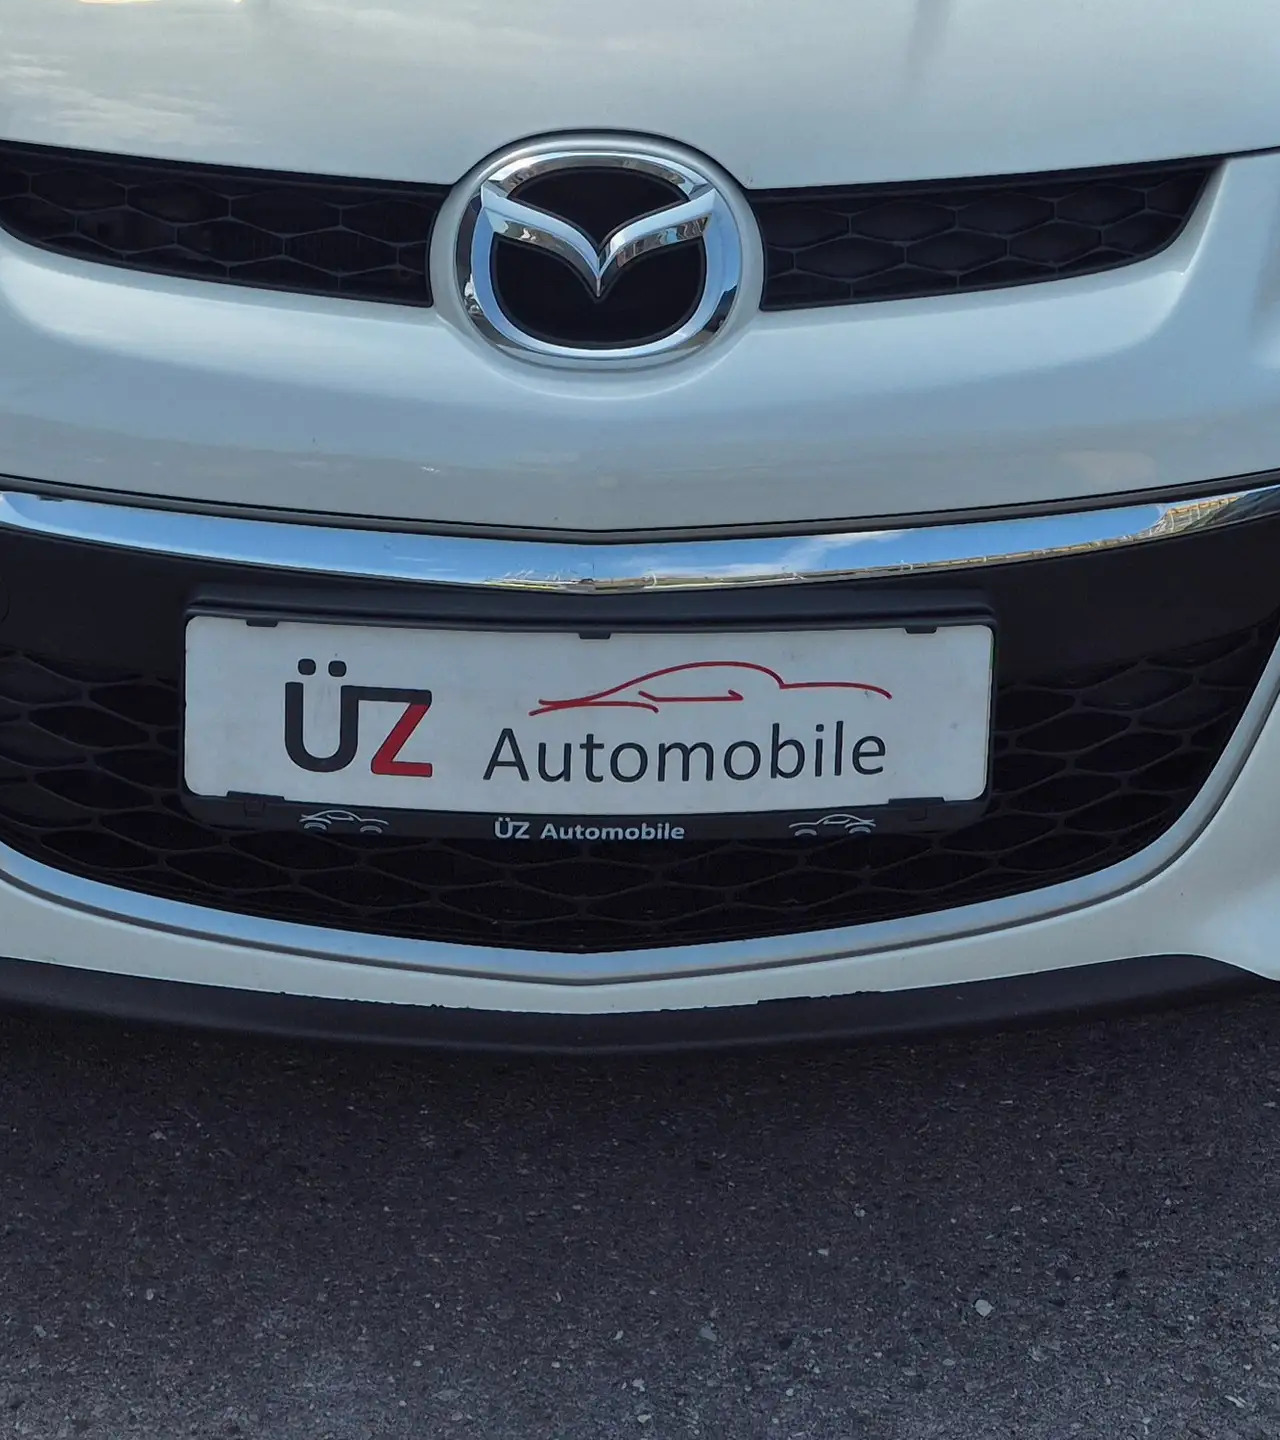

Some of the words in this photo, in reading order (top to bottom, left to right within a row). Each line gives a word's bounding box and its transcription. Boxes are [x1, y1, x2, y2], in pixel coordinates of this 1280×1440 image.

[283, 657, 433, 778] ÜZ
[483, 720, 888, 784] Automobile
[494, 817, 531, 840] ÜZ
[540, 822, 685, 841] Automobile
